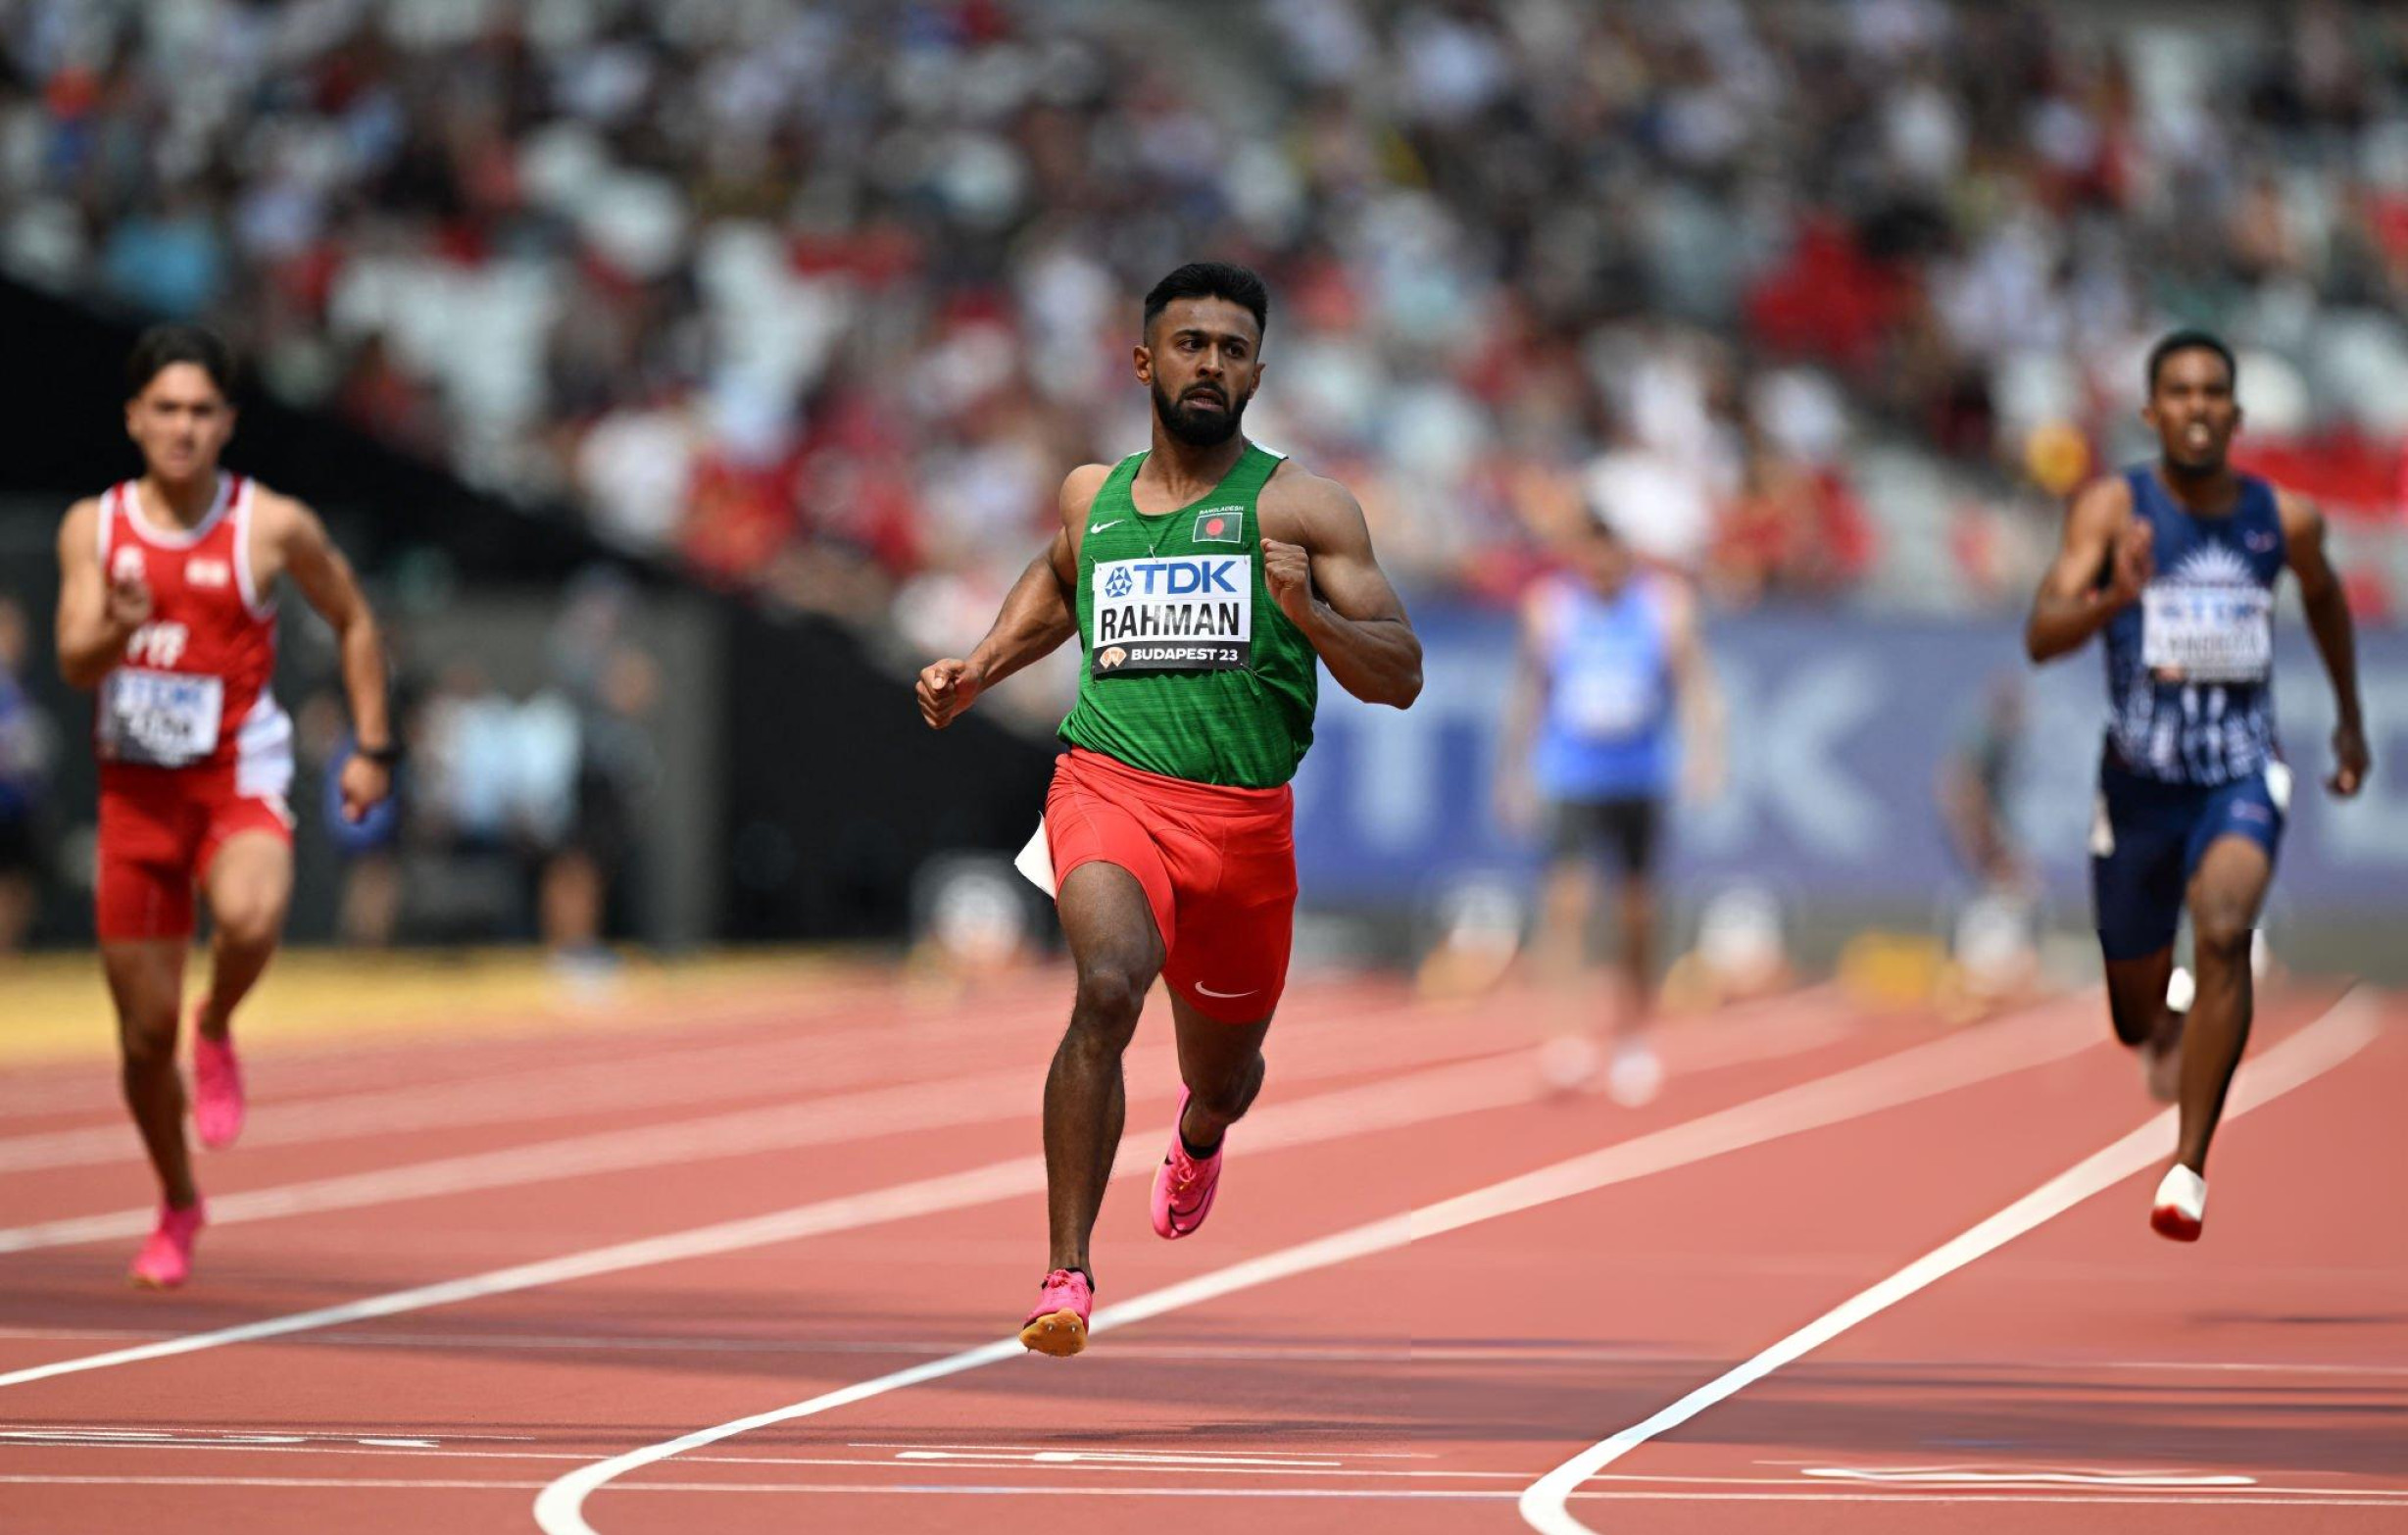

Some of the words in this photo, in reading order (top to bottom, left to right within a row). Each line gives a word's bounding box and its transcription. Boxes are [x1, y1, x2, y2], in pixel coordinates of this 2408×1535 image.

[1133, 561, 1238, 595] TDK
[1101, 602, 1240, 642] RAHMAN
[1131, 648, 1218, 662] BUDAPEST
[1219, 649, 1238, 662] 23
